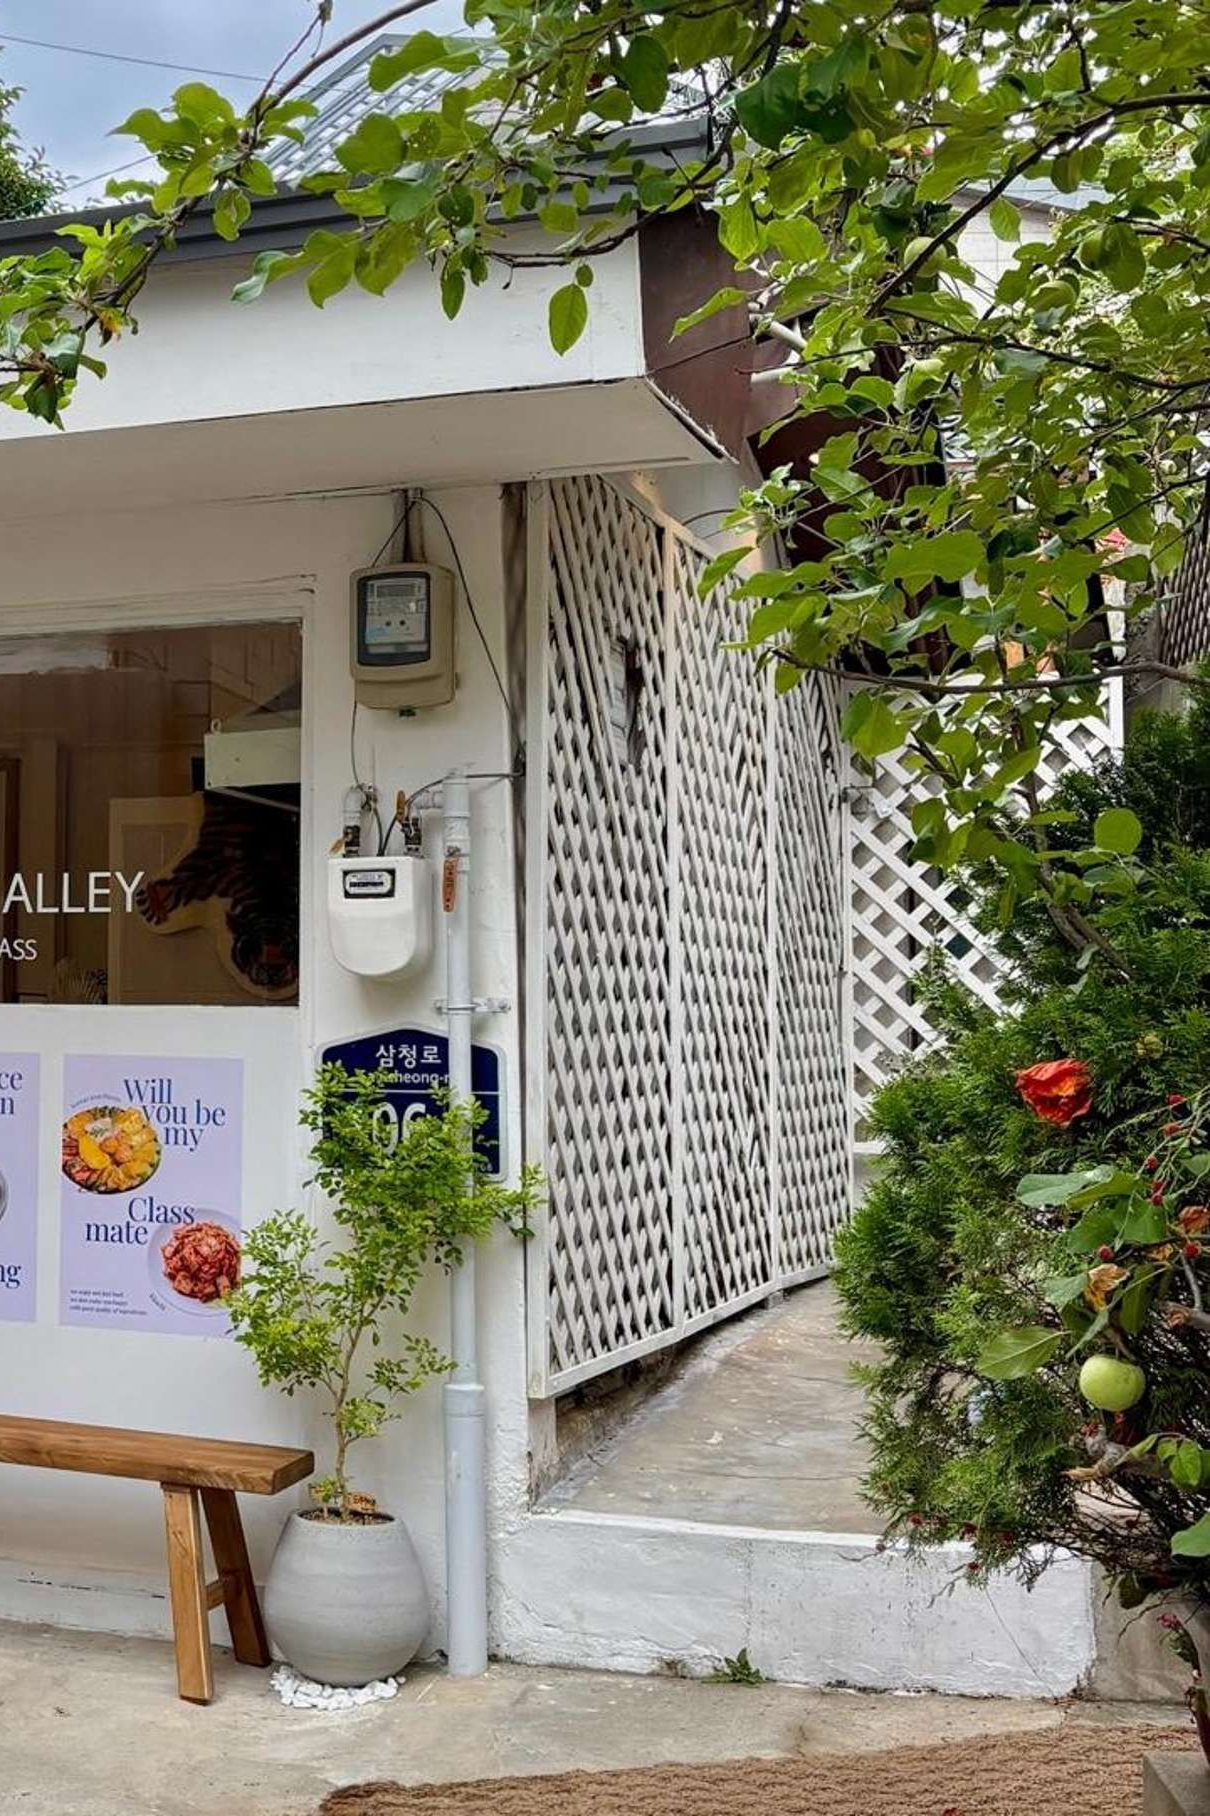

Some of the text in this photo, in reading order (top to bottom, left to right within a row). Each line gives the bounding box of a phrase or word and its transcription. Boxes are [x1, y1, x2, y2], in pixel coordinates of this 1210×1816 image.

[2, 871, 145, 914] ALLEY
[376, 1044, 442, 1069] 삼청로
[123, 1078, 173, 1104] Will
[142, 1099, 226, 1127] you be
[164, 1127, 204, 1152] my
[128, 1196, 196, 1225] Class
[85, 1221, 148, 1246] mate
